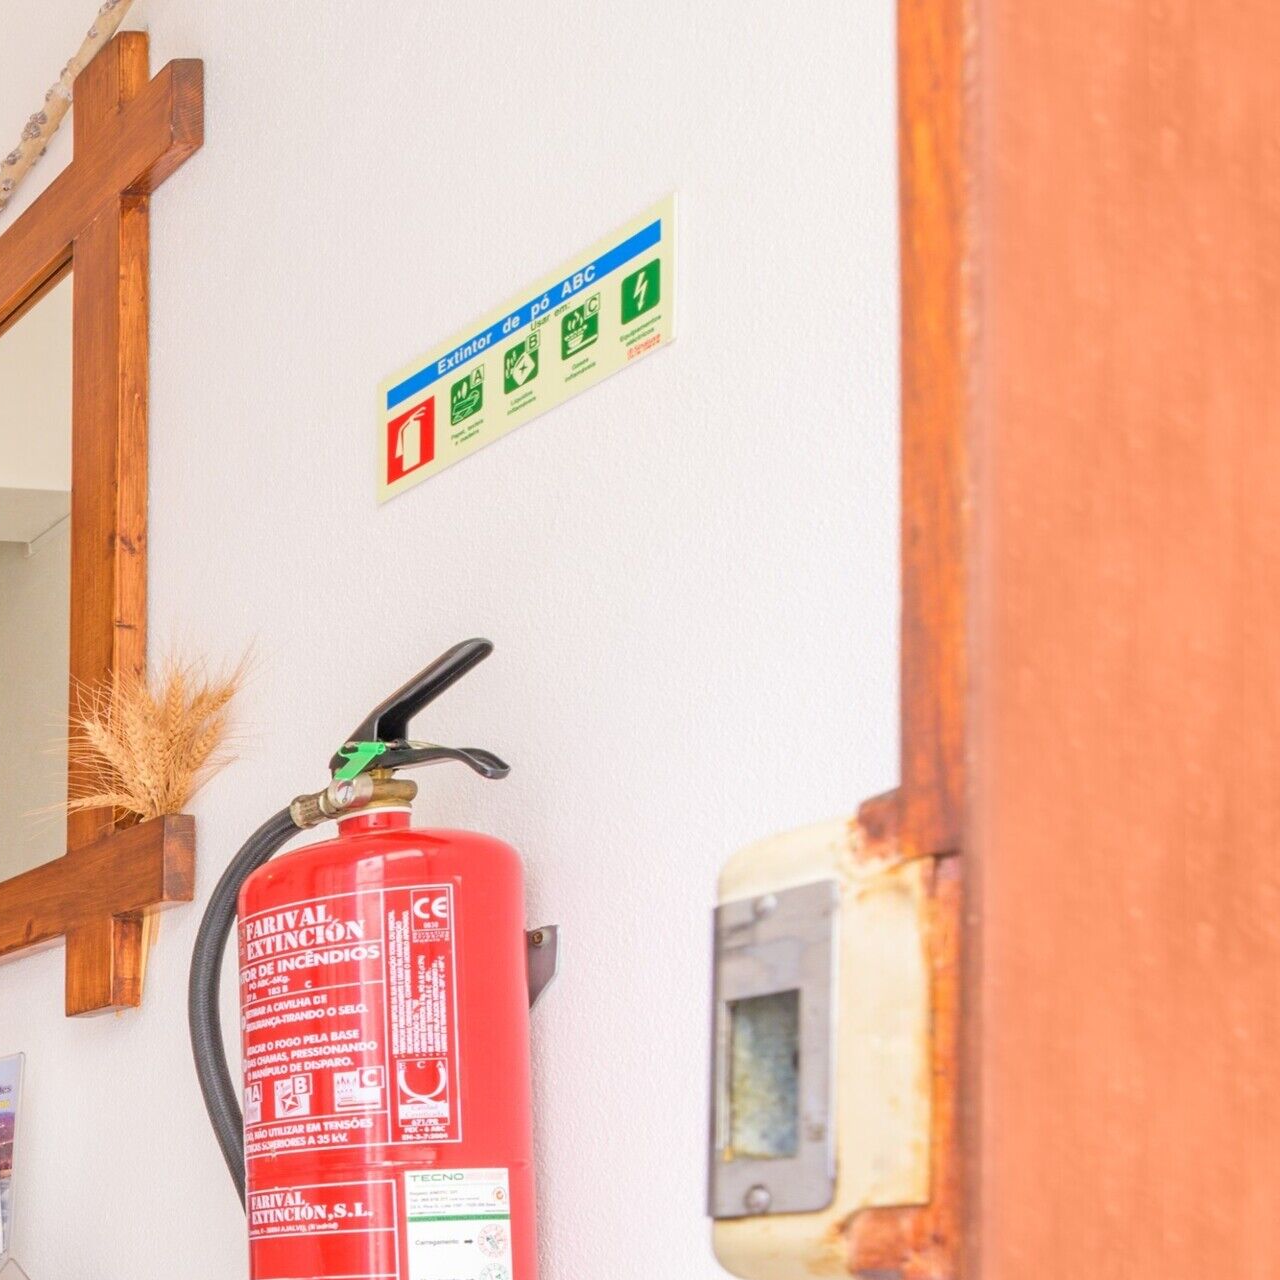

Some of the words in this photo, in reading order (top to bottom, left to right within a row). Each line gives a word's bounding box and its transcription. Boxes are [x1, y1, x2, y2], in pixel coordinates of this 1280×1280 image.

[588, 297, 598, 312] C
[437, 331, 493, 376] Extintor
[502, 314, 520, 335] de
[530, 294, 550, 321] pó
[561, 265, 596, 298] ABC
[528, 334, 538, 350] B
[473, 370, 483, 384] A
[413, 896, 447, 919] CE
[246, 904, 332, 942] FARIVAL
[247, 918, 366, 961] EXTINCIÓN
[258, 962, 274, 976] DE
[277, 945, 381, 973] INCÊNDIOS
[304, 980, 313, 989] C
[273, 996, 312, 1012] CAVILHA
[313, 994, 328, 1005] DE
[326, 1006, 337, 1017] O
[338, 1003, 368, 1015] SELO.
[267, 1041, 274, 1051] O
[275, 1036, 301, 1049] FOGO
[303, 1032, 328, 1044] PELA
[330, 1029, 360, 1041] BASE
[257, 1051, 289, 1067] CHAMAS,
[291, 1041, 378, 1060] PRESSIONANDO
[289, 1061, 303, 1073] DE
[304, 1057, 354, 1071] DISPARO.
[251, 1084, 260, 1101] A
[294, 1076, 308, 1094] B
[362, 1068, 378, 1086] C
[268, 1123, 304, 1137] UTILIZAR
[306, 1121, 321, 1132] EM
[322, 1117, 373, 1130] TENSÕES
[307, 1135, 316, 1146] A
[316, 1134, 330, 1145] 35
[331, 1132, 348, 1143] kV.
[409, 1173, 465, 1182] TECNO
[251, 1191, 305, 1211] FARIVAL
